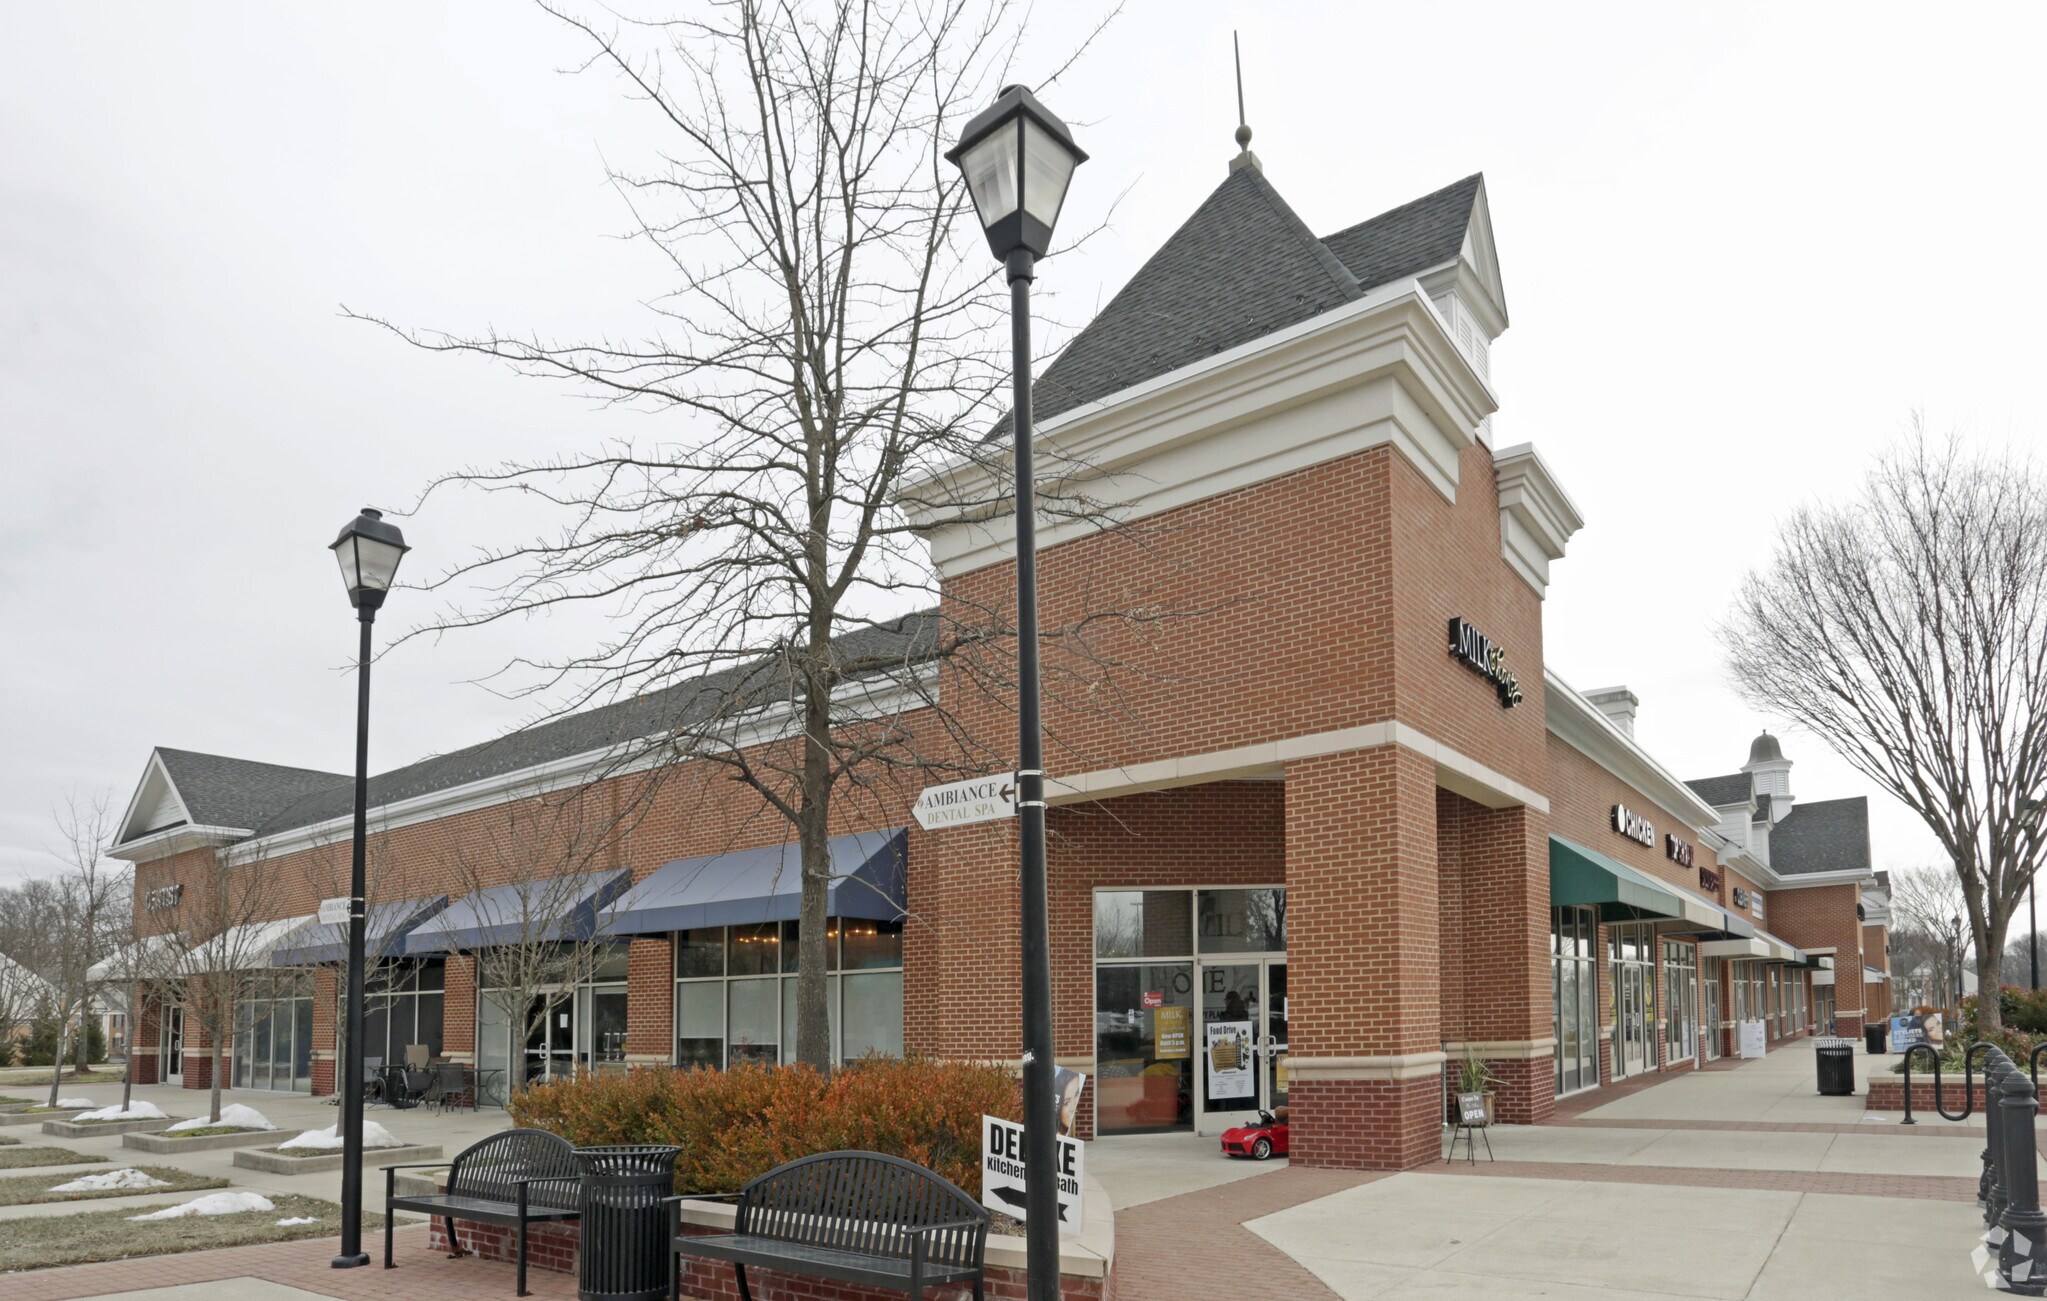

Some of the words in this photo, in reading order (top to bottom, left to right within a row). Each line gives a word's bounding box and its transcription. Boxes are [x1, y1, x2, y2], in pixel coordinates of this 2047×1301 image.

[1459, 617, 1493, 676] MILK
[925, 783, 997, 809] AMBIANCE
[928, 805, 970, 824] DENTAL
[975, 803, 995, 816] SPA
[1626, 809, 1655, 848] CHICKEN
[1144, 997, 1162, 1006] Open
[1210, 1026, 1223, 1035] Food
[1223, 1025, 1237, 1034] Drive
[1464, 1109, 1484, 1120] OPEN
